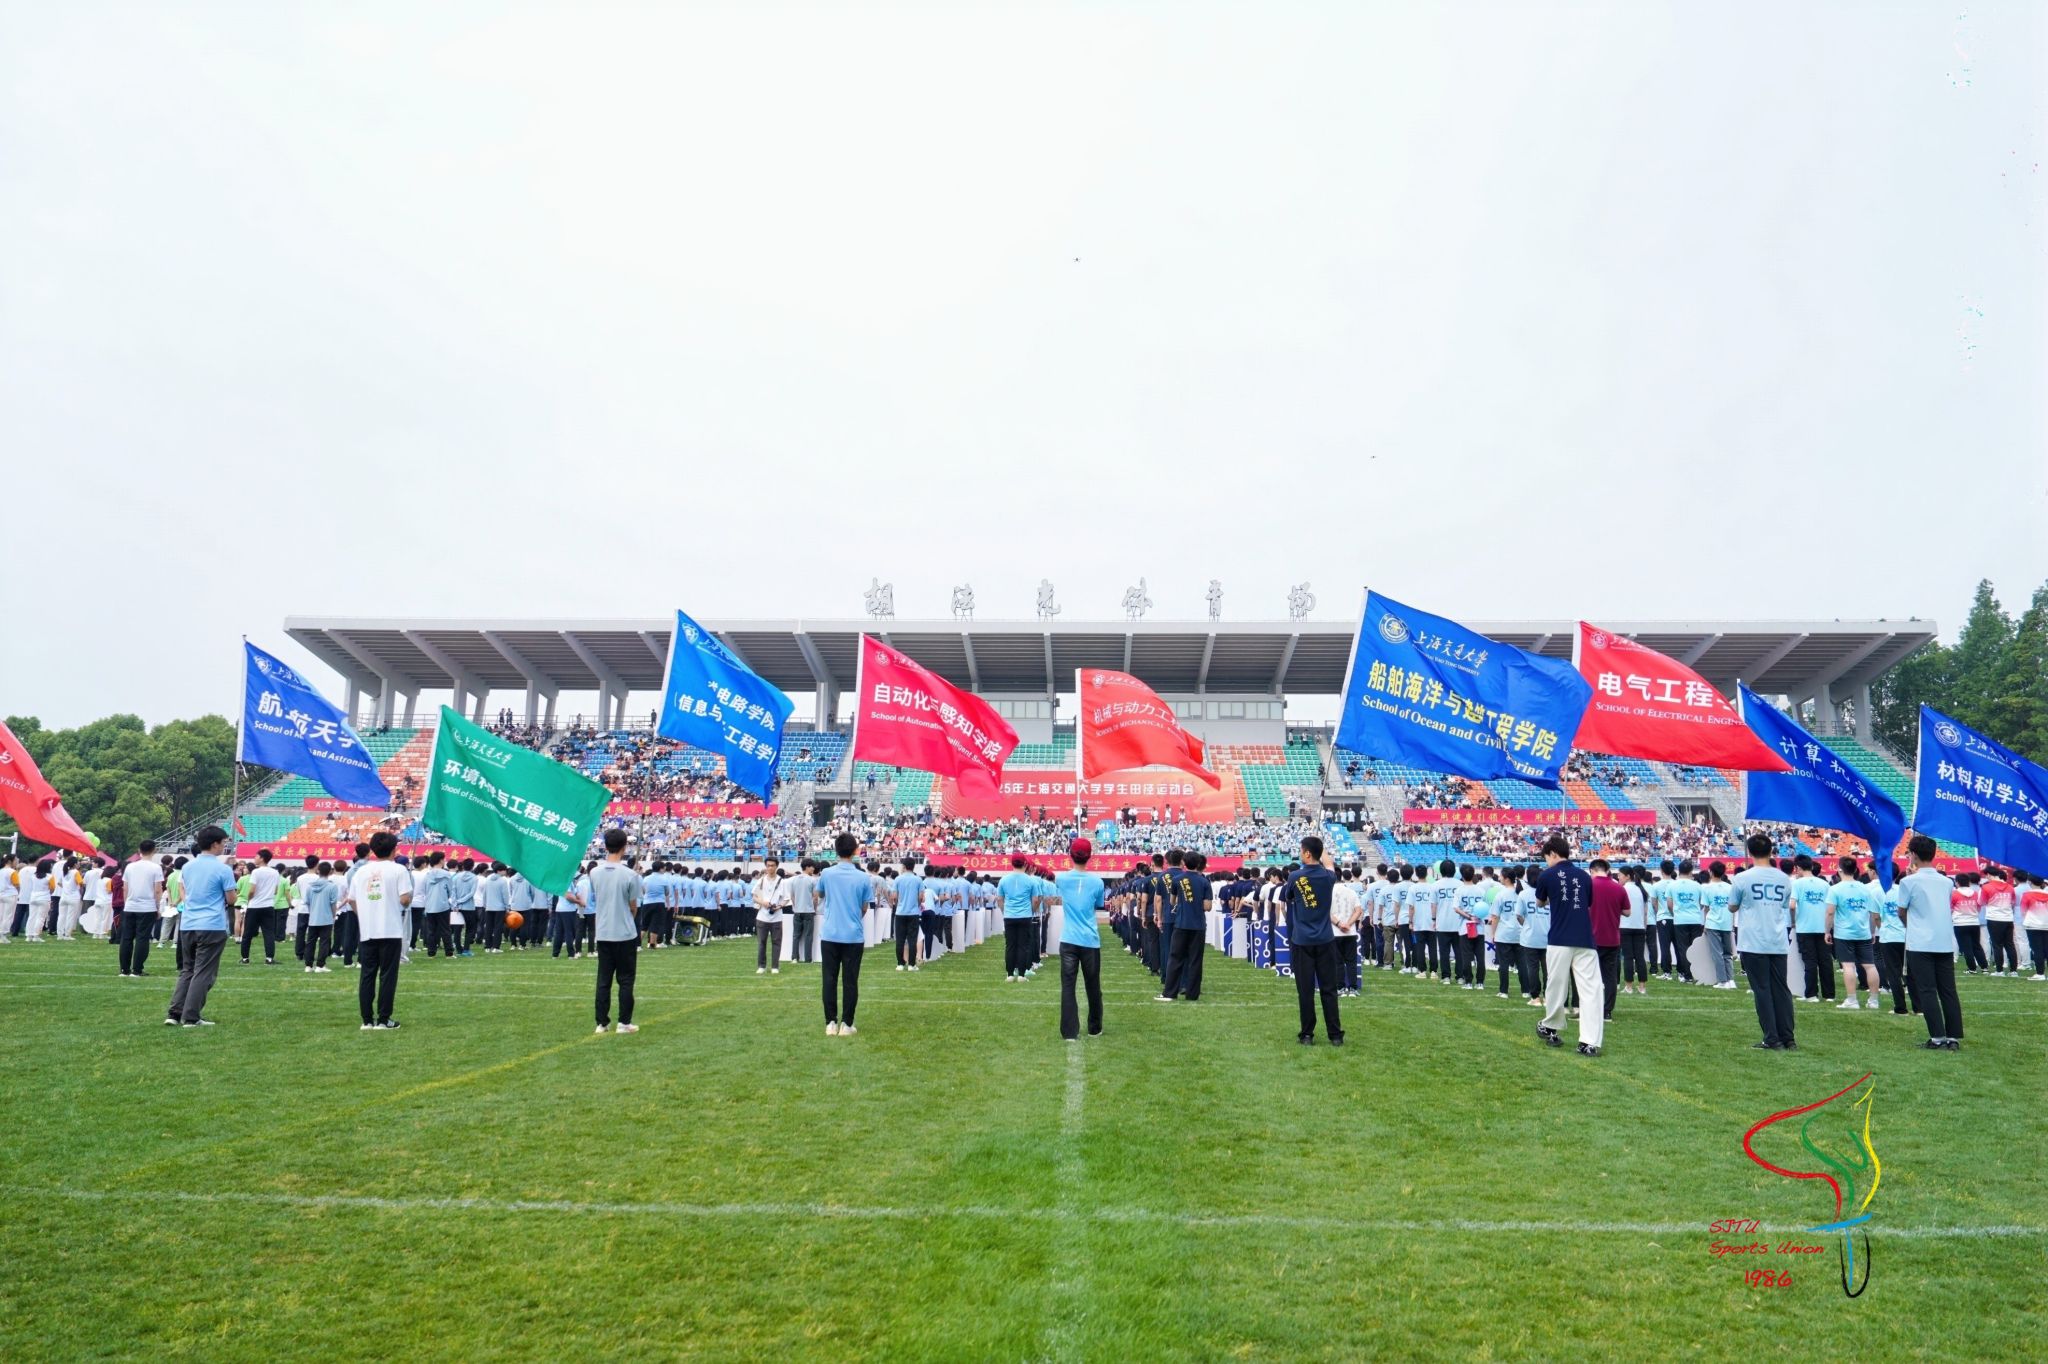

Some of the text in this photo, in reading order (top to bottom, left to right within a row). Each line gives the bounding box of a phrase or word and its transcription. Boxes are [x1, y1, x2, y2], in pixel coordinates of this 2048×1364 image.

[1413, 631, 1488, 669] 上海交通大学
[708, 680, 775, 731] 电路学院
[1597, 672, 1731, 711] 电气工程
[871, 712, 896, 721] School
[1362, 695, 1397, 715] School
[1399, 709, 1411, 720] of
[1411, 712, 1447, 733] Ocean
[1449, 726, 1473, 740] and
[1596, 702, 1631, 715] SCHOOL
[1634, 708, 1646, 716] OF
[1647, 709, 1705, 723] ELECTRICAL
[254, 721, 282, 734] School
[284, 729, 293, 737] of
[312, 749, 327, 759] and
[328, 753, 372, 770] Astronau
[464, 736, 513, 765] 上海交通大学
[441, 783, 460, 795] School
[529, 829, 568, 852] Engineering
[1440, 811, 1523, 823] 用健康引领人生
[1936, 789, 1966, 803] School
[1970, 800, 2009, 825] Materials
[1415, 891, 1430, 902] SC
[1751, 883, 1785, 901] SCS
